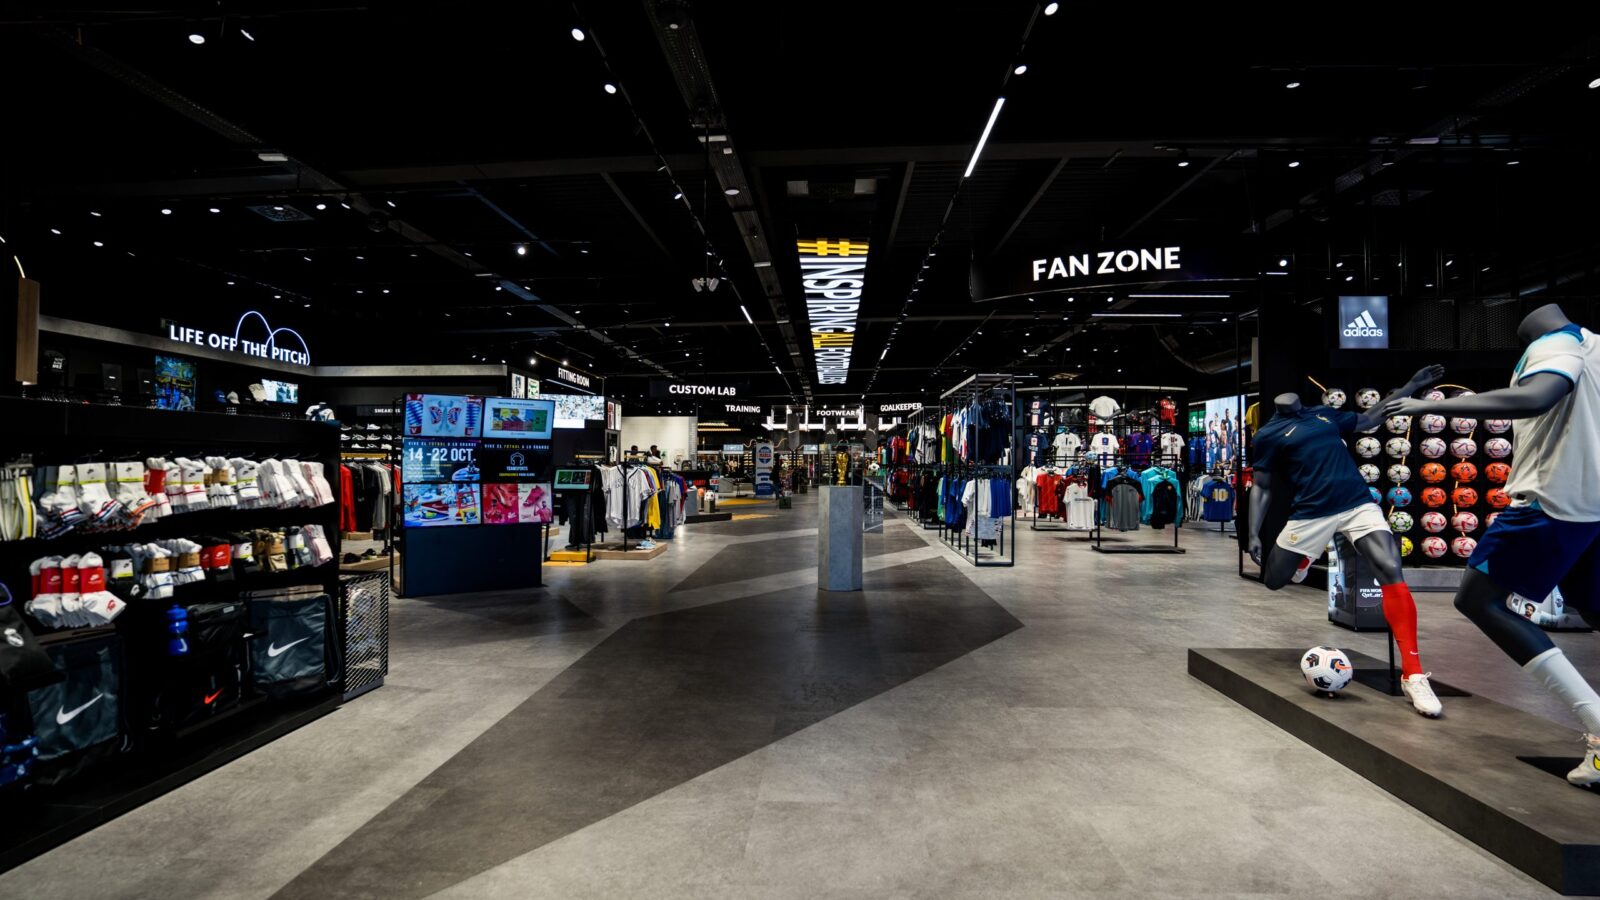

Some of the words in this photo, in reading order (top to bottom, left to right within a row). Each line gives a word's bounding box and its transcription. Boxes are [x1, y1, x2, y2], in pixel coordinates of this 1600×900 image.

[1033, 254, 1089, 281] FAN
[1097, 246, 1181, 275] ZONE
[1343, 326, 1383, 337] adidas
[170, 324, 204, 346] LIFE
[208, 333, 237, 352] OFF
[241, 340, 268, 358] THE
[272, 347, 307, 366] PITCH
[558, 367, 576, 384] FITTING
[576, 374, 590, 388] ROOM
[669, 384, 715, 396] CUSTOM
[717, 386, 736, 396] LAB
[725, 404, 760, 413] TRAINING
[816, 409, 855, 417] FOOTWEAR
[880, 402, 922, 412] GOALKEEPER
[408, 447, 424, 461] 14
[450, 447, 477, 462] OCT.
[1212, 488, 1229, 502] 10
